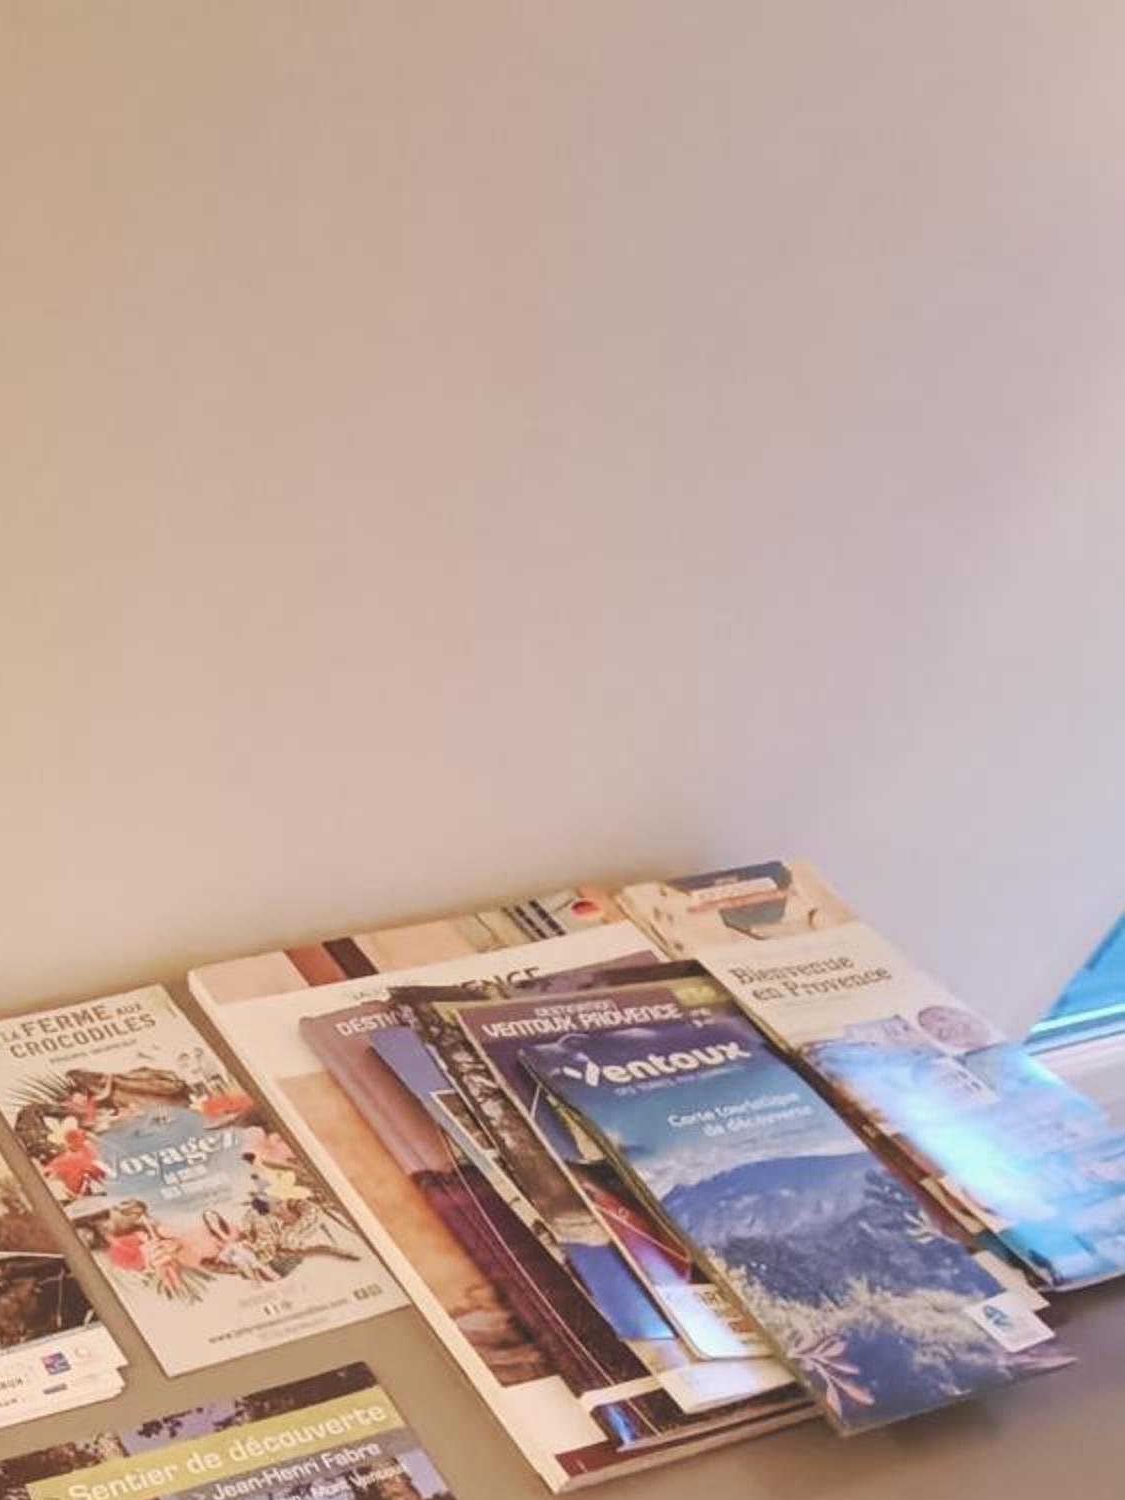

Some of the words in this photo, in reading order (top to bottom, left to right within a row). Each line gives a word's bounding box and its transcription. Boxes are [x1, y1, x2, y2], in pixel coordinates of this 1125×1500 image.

[728, 956, 855, 985] Bienvenue
[752, 987, 782, 1001] en
[784, 967, 891, 998] Provence
[10, 1014, 156, 1059] CROCODILES
[20, 1005, 110, 1037] FERME
[482, 1014, 576, 1038] VENTOUX
[578, 1004, 682, 1029] PROVENCE
[561, 1041, 751, 1087] Ventoux
[187, 1451, 222, 1476] de
[232, 1404, 388, 1460] découverte
[322, 1442, 381, 1470] Fabre
